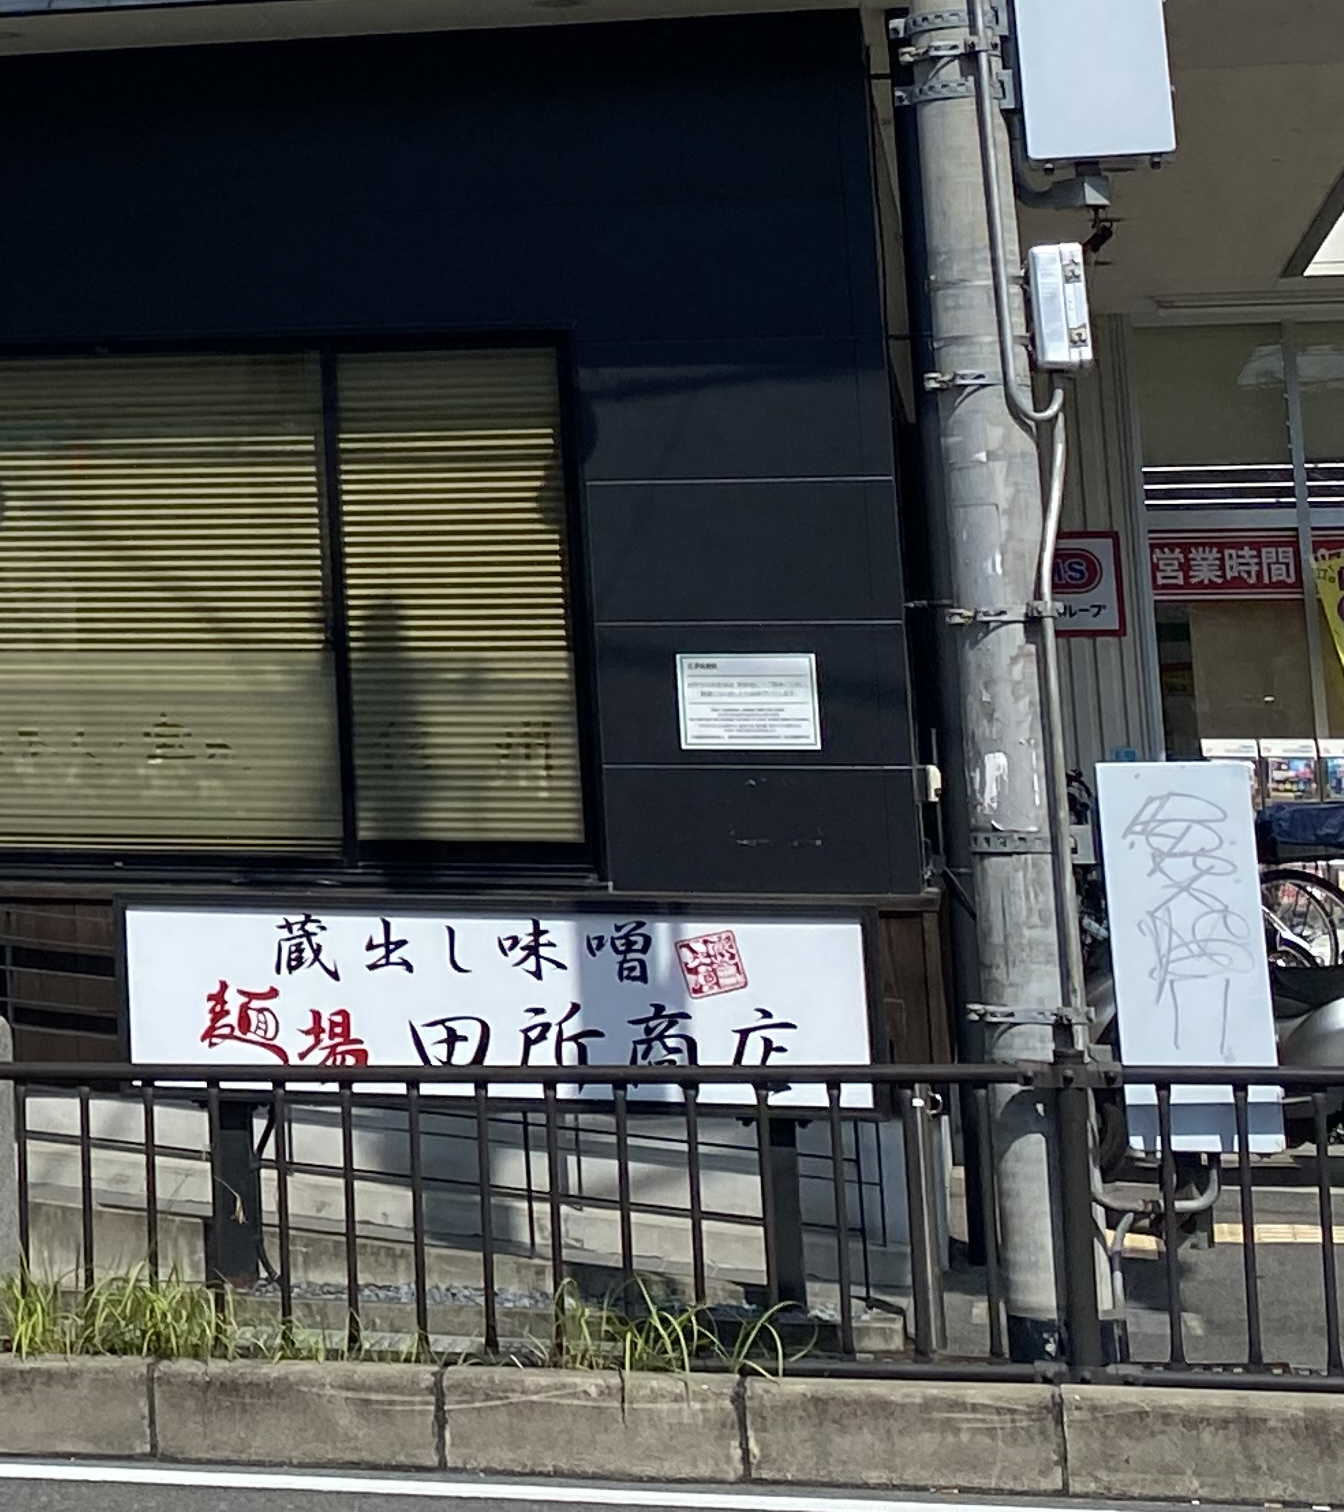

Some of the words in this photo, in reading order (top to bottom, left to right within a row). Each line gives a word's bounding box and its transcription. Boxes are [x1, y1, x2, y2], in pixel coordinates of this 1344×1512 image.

[1152, 545, 1297, 586] 営業時間
[274, 914, 654, 984] 蔵出し味噌
[200, 978, 370, 1073] 麺場
[408, 1001, 799, 1090] 田所商店
